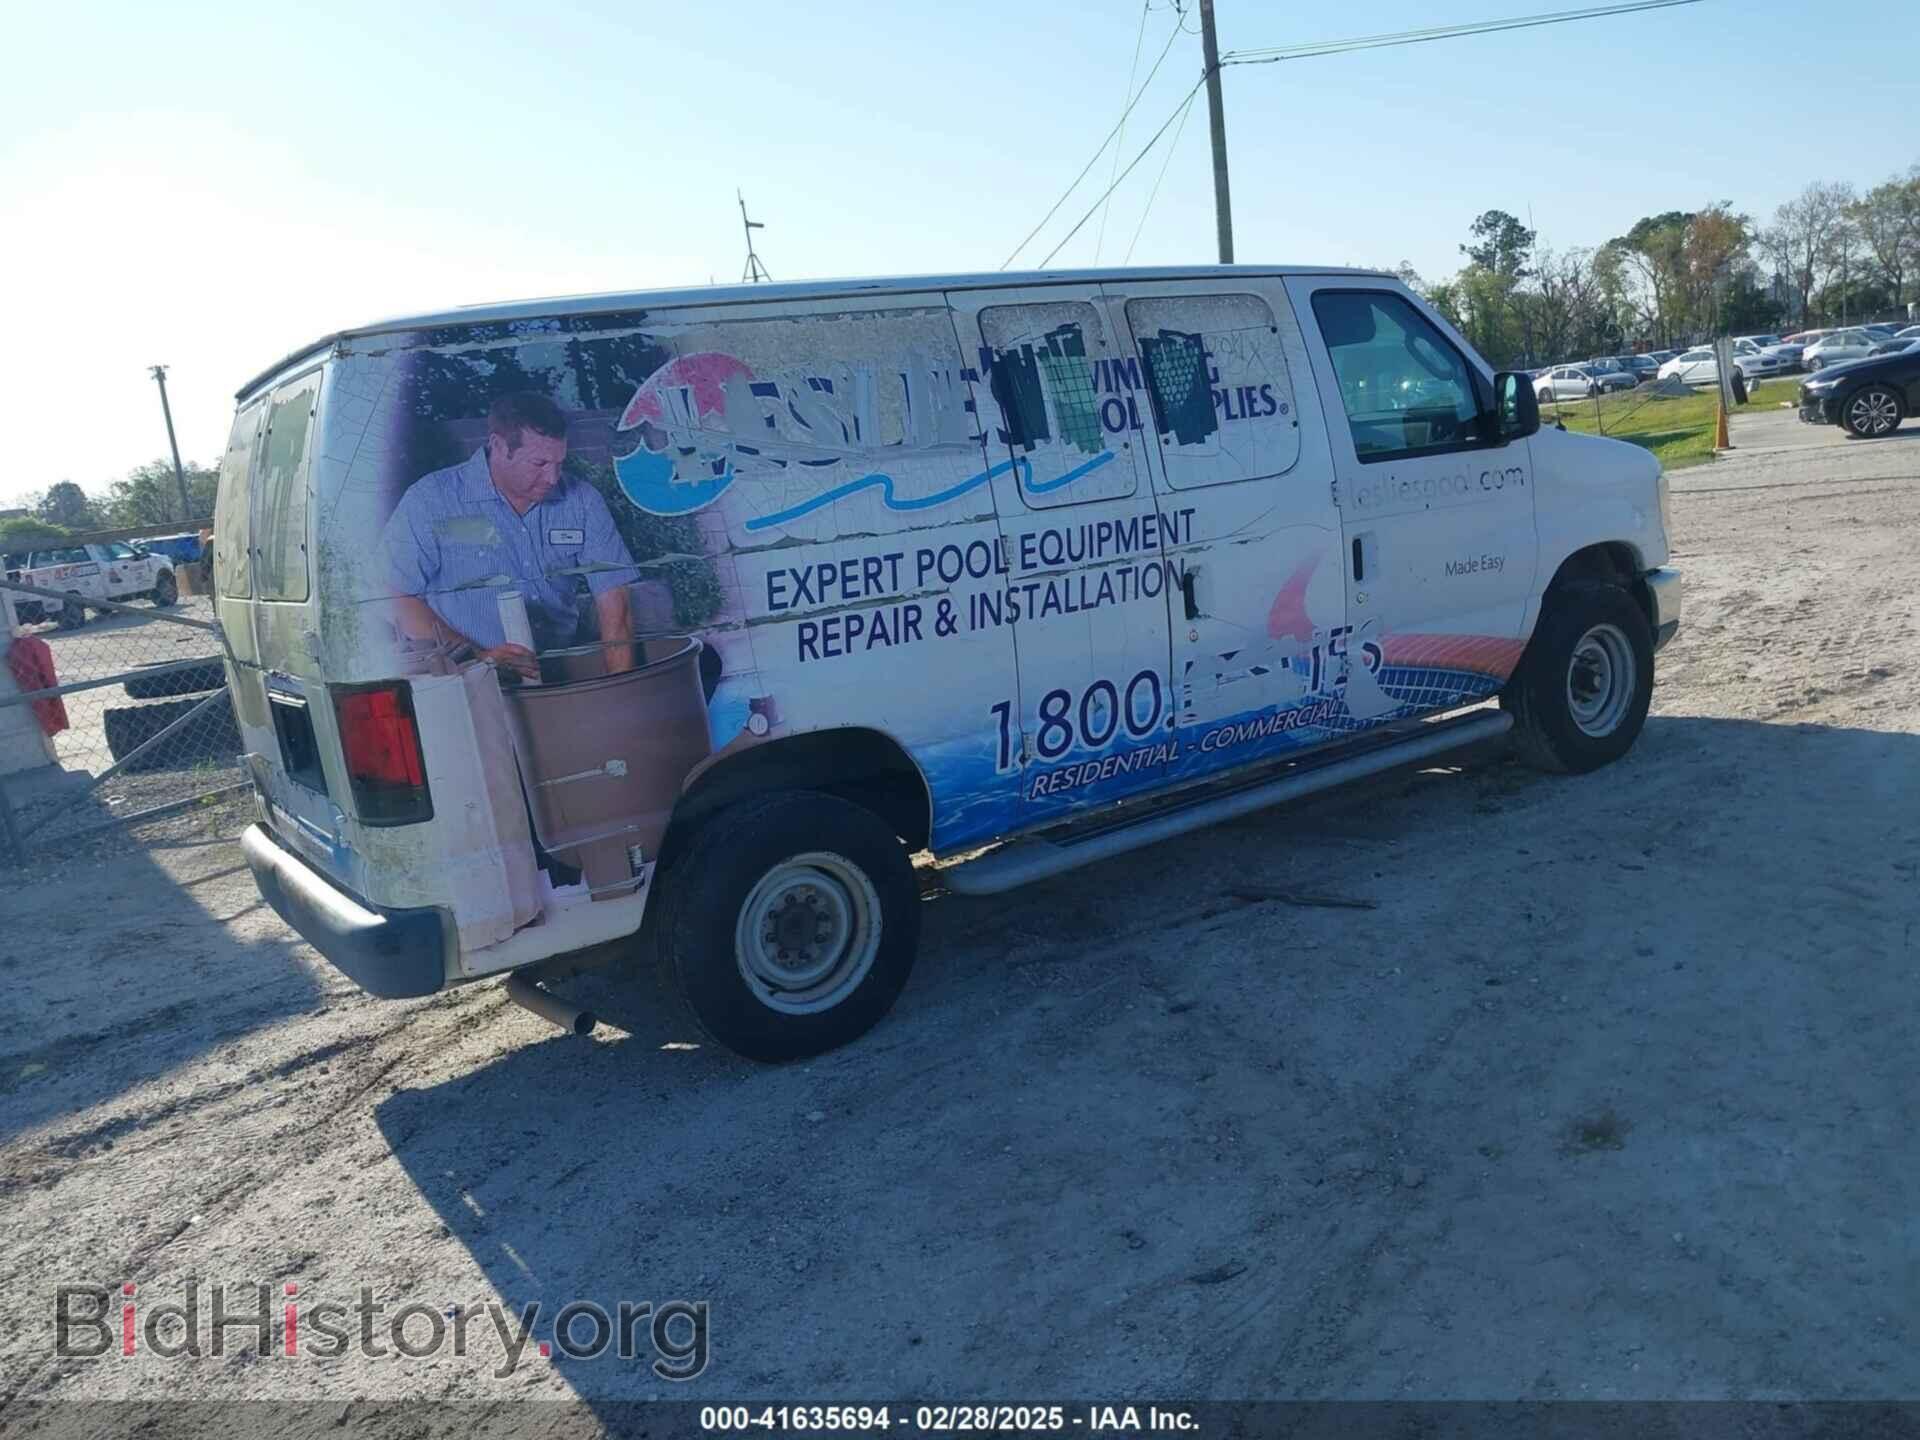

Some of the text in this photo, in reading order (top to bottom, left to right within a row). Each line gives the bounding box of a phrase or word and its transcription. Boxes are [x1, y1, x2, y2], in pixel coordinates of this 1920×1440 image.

[767, 508, 1196, 611] EXPERT POOL EQUIPMENT
[798, 558, 1185, 662] REPAIR & INSTALLATION
[1445, 554, 1505, 576] Made Easy
[1031, 741, 1179, 799] RESIDENTIAL
[1200, 698, 1341, 753] COMMERCIAL
